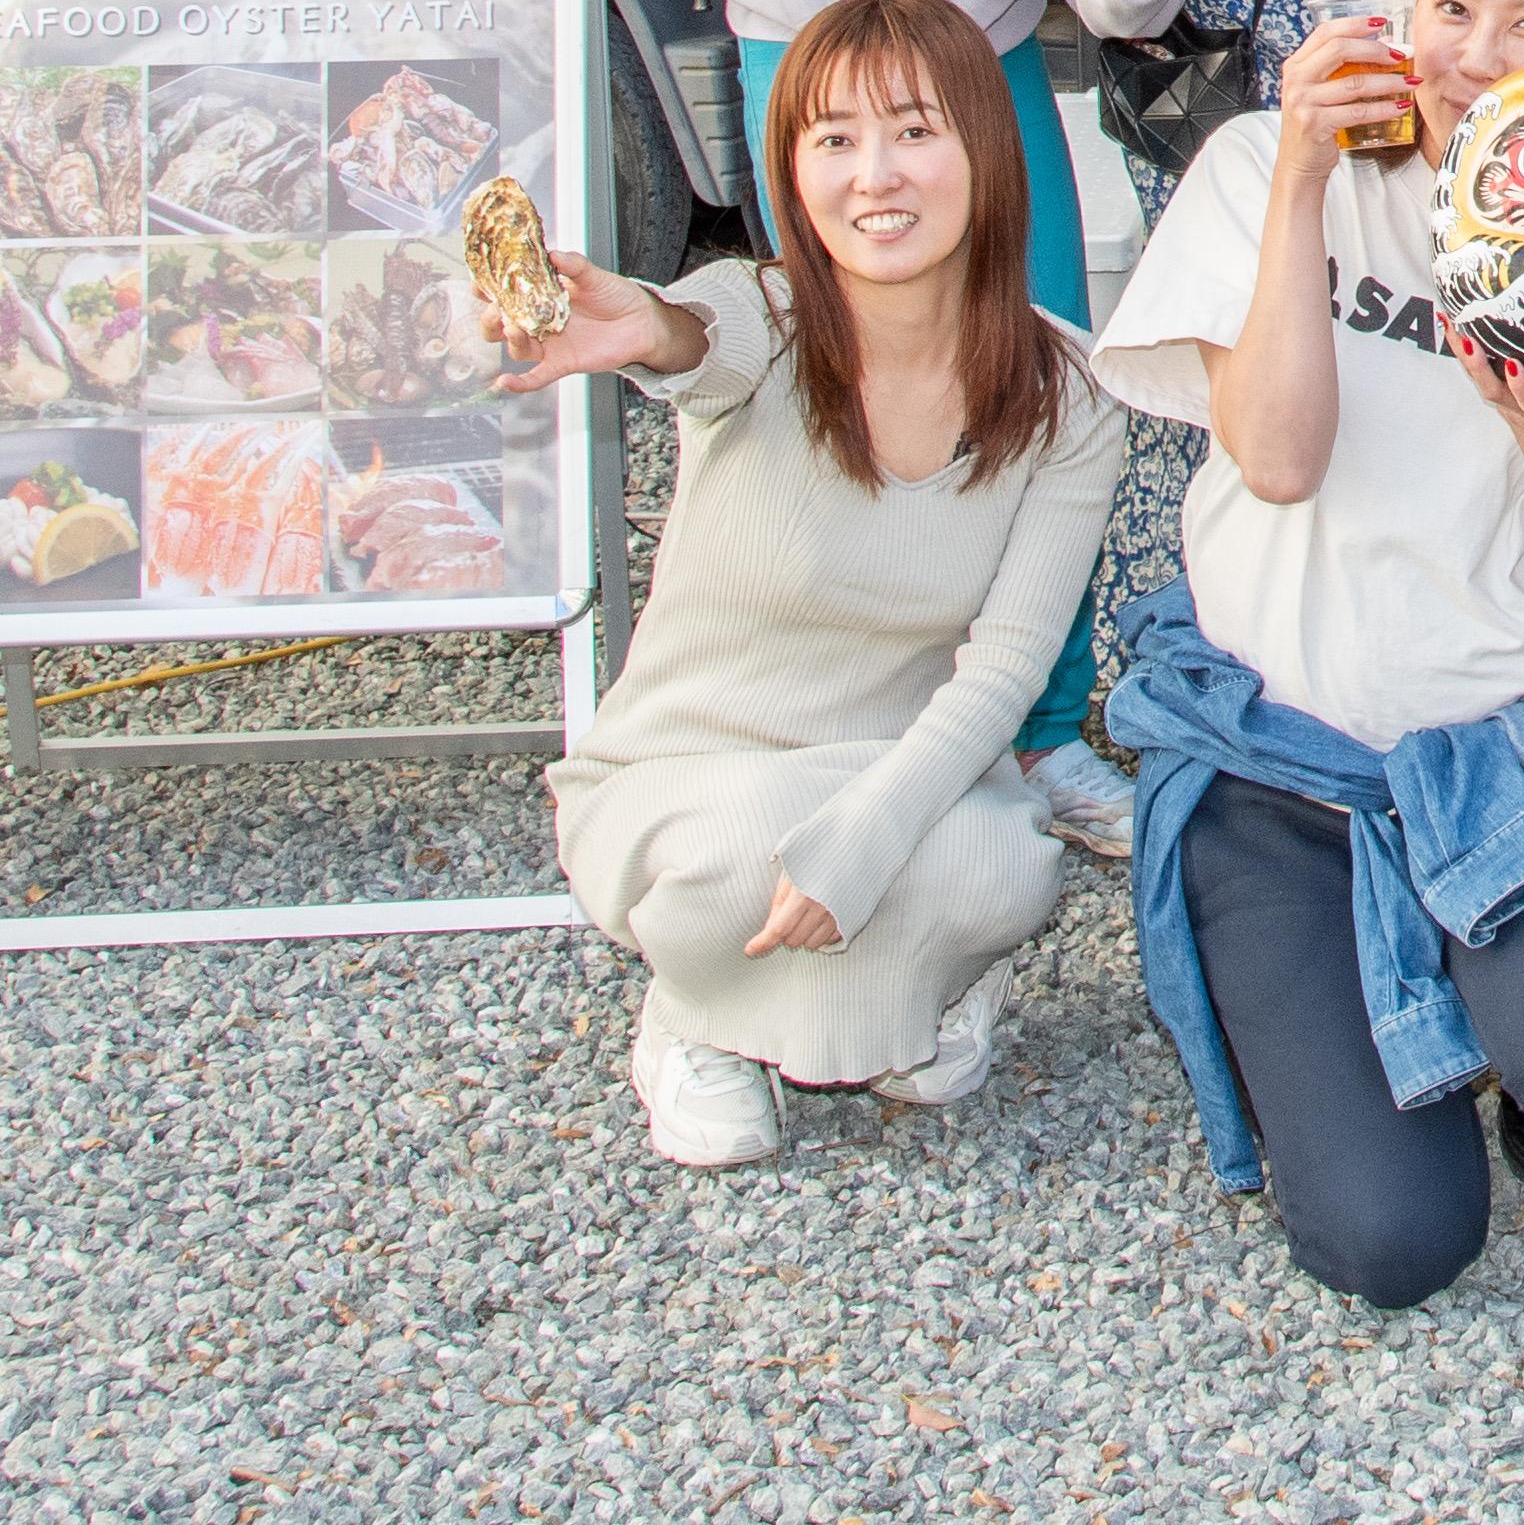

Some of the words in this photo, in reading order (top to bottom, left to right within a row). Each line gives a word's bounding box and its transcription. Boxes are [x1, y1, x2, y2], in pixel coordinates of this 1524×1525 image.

[0, 5, 162, 39] AFOOD
[179, 3, 350, 36] OYSTER
[371, 0, 495, 32] YATAI
